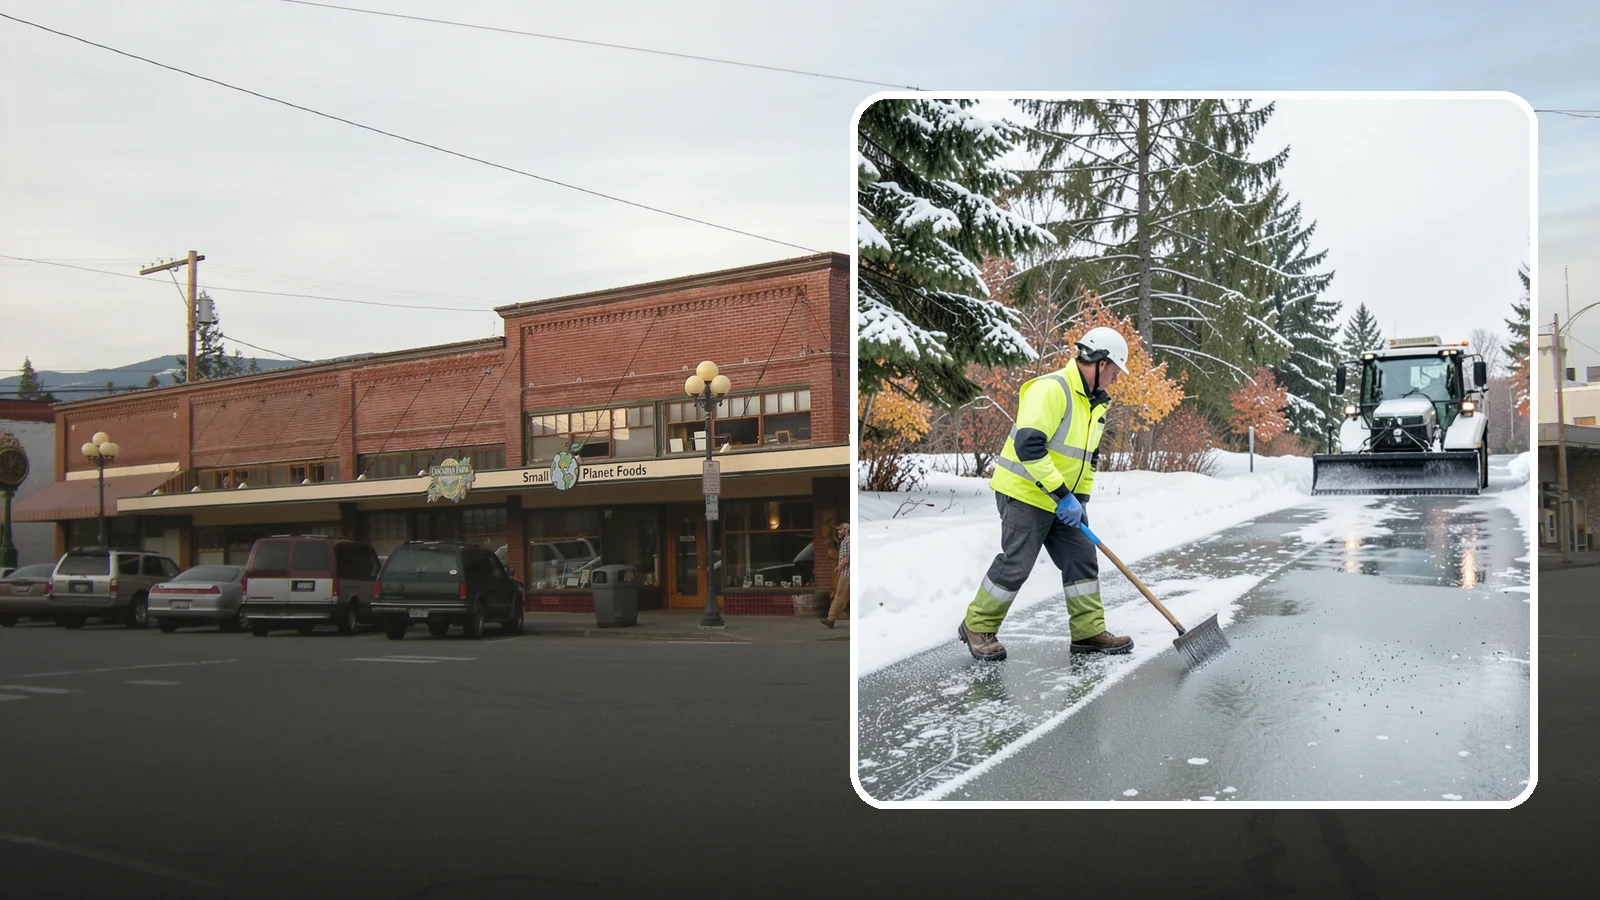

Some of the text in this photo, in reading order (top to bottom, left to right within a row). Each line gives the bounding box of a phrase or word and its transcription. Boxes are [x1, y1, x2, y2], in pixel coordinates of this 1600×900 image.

[523, 464, 647, 483] Small Planet Foods
